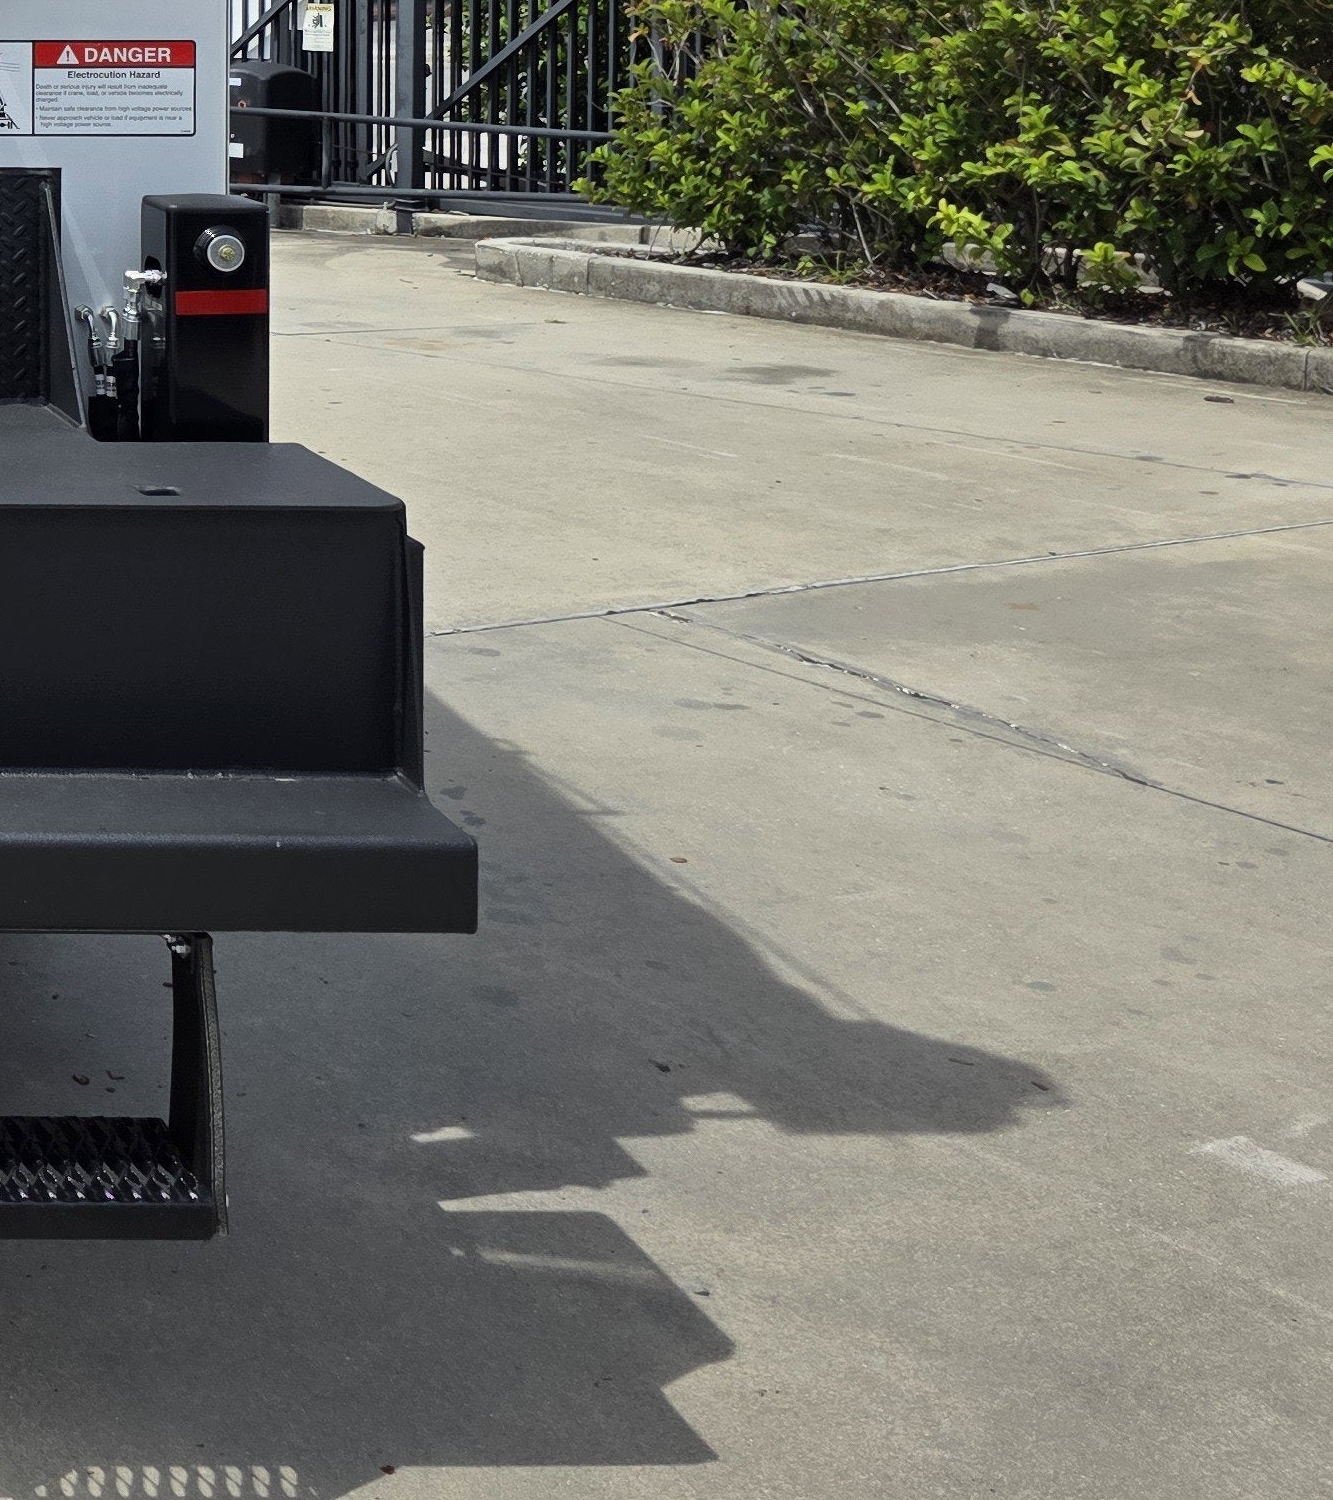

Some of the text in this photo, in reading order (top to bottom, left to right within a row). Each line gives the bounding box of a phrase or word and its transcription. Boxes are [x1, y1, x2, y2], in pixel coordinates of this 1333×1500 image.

[84, 47, 171, 63] DANGER
[67, 70, 161, 79] Electrocution Hazard
